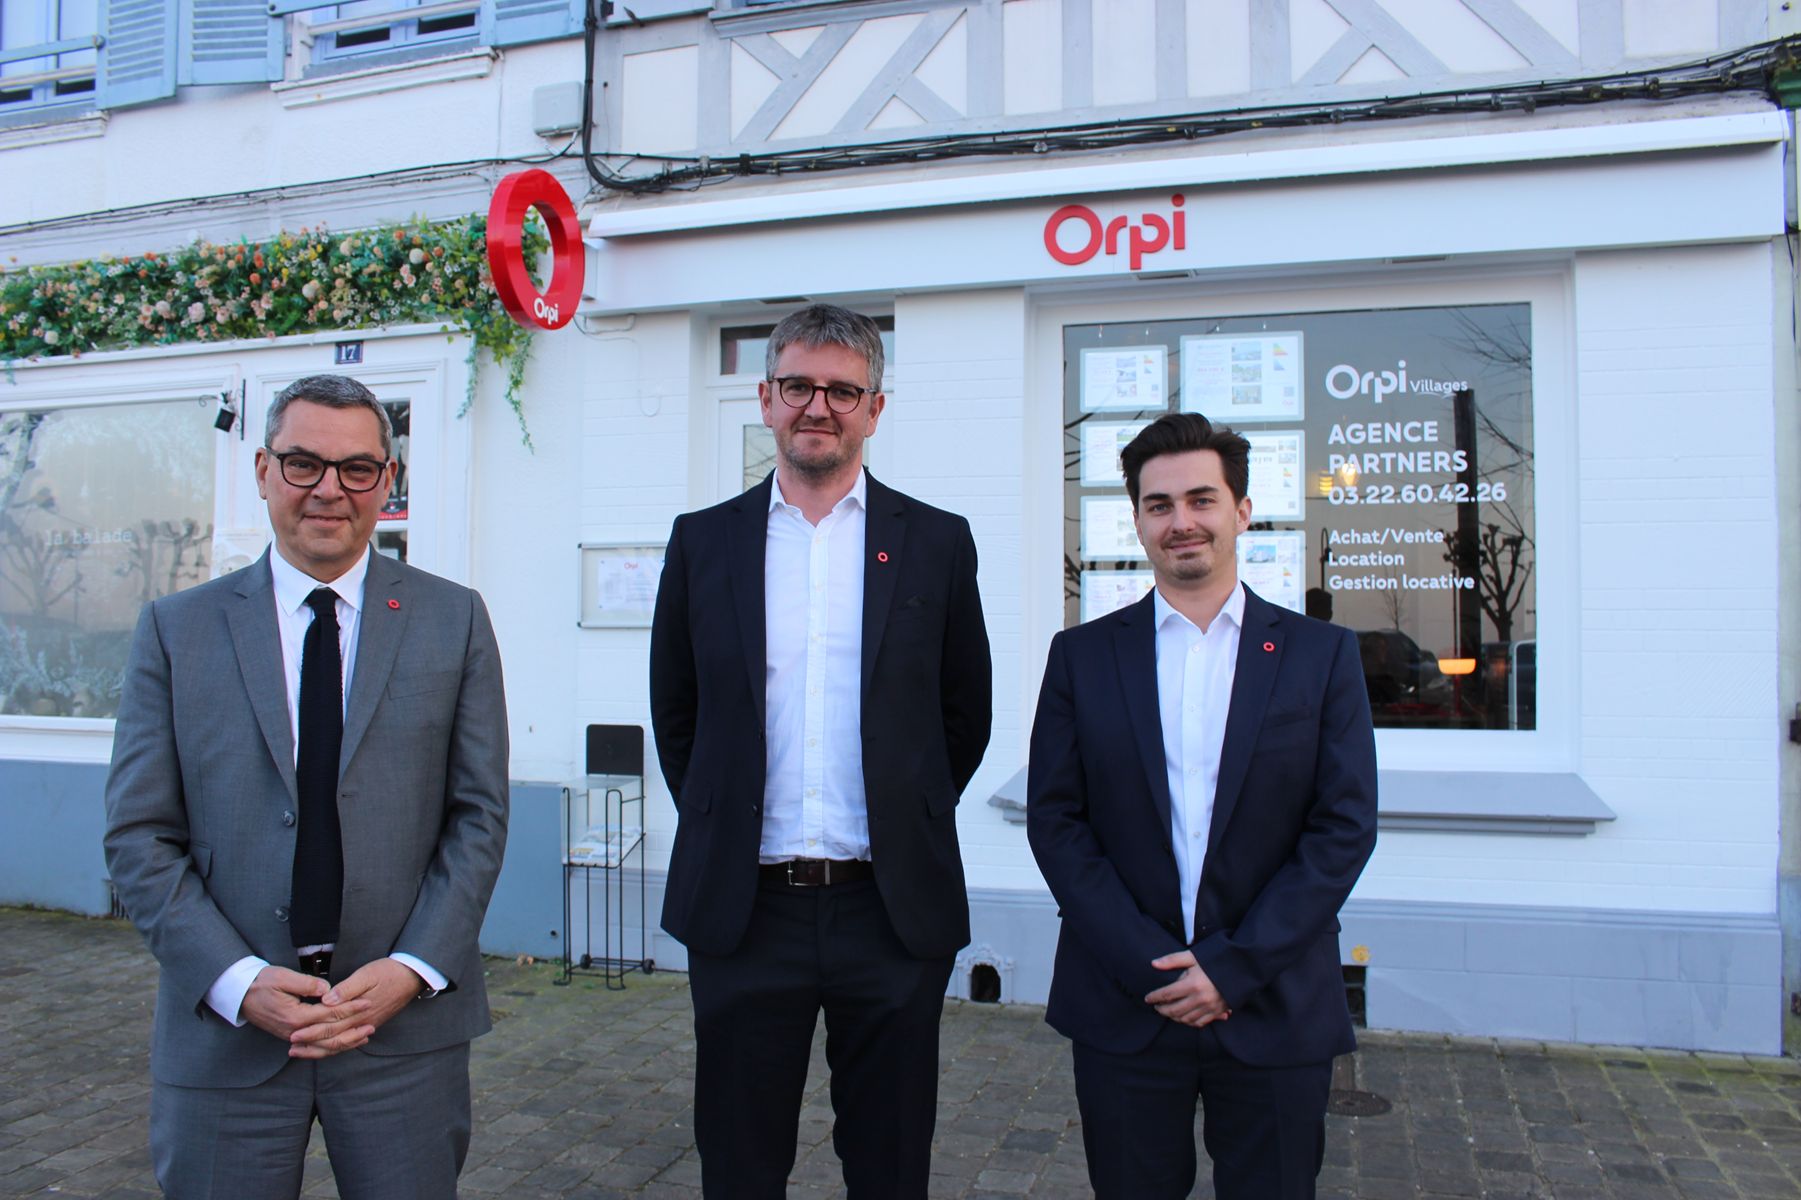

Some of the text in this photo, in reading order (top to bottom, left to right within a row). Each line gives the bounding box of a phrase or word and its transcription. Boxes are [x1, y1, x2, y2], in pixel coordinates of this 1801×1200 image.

[1044, 193, 1185, 270] Orpi
[533, 296, 559, 325] Orpi
[340, 344, 357, 361] 17
[1325, 360, 1468, 403] Orpi Villages
[1328, 421, 1438, 444] AGENCE
[1329, 450, 1468, 474] PARTNERS
[1328, 482, 1506, 504] 03.22.60.42.26
[1329, 528, 1444, 545] Achat/Vente
[1328, 550, 1404, 567] Location
[1329, 573, 1475, 590] Gestion locative
